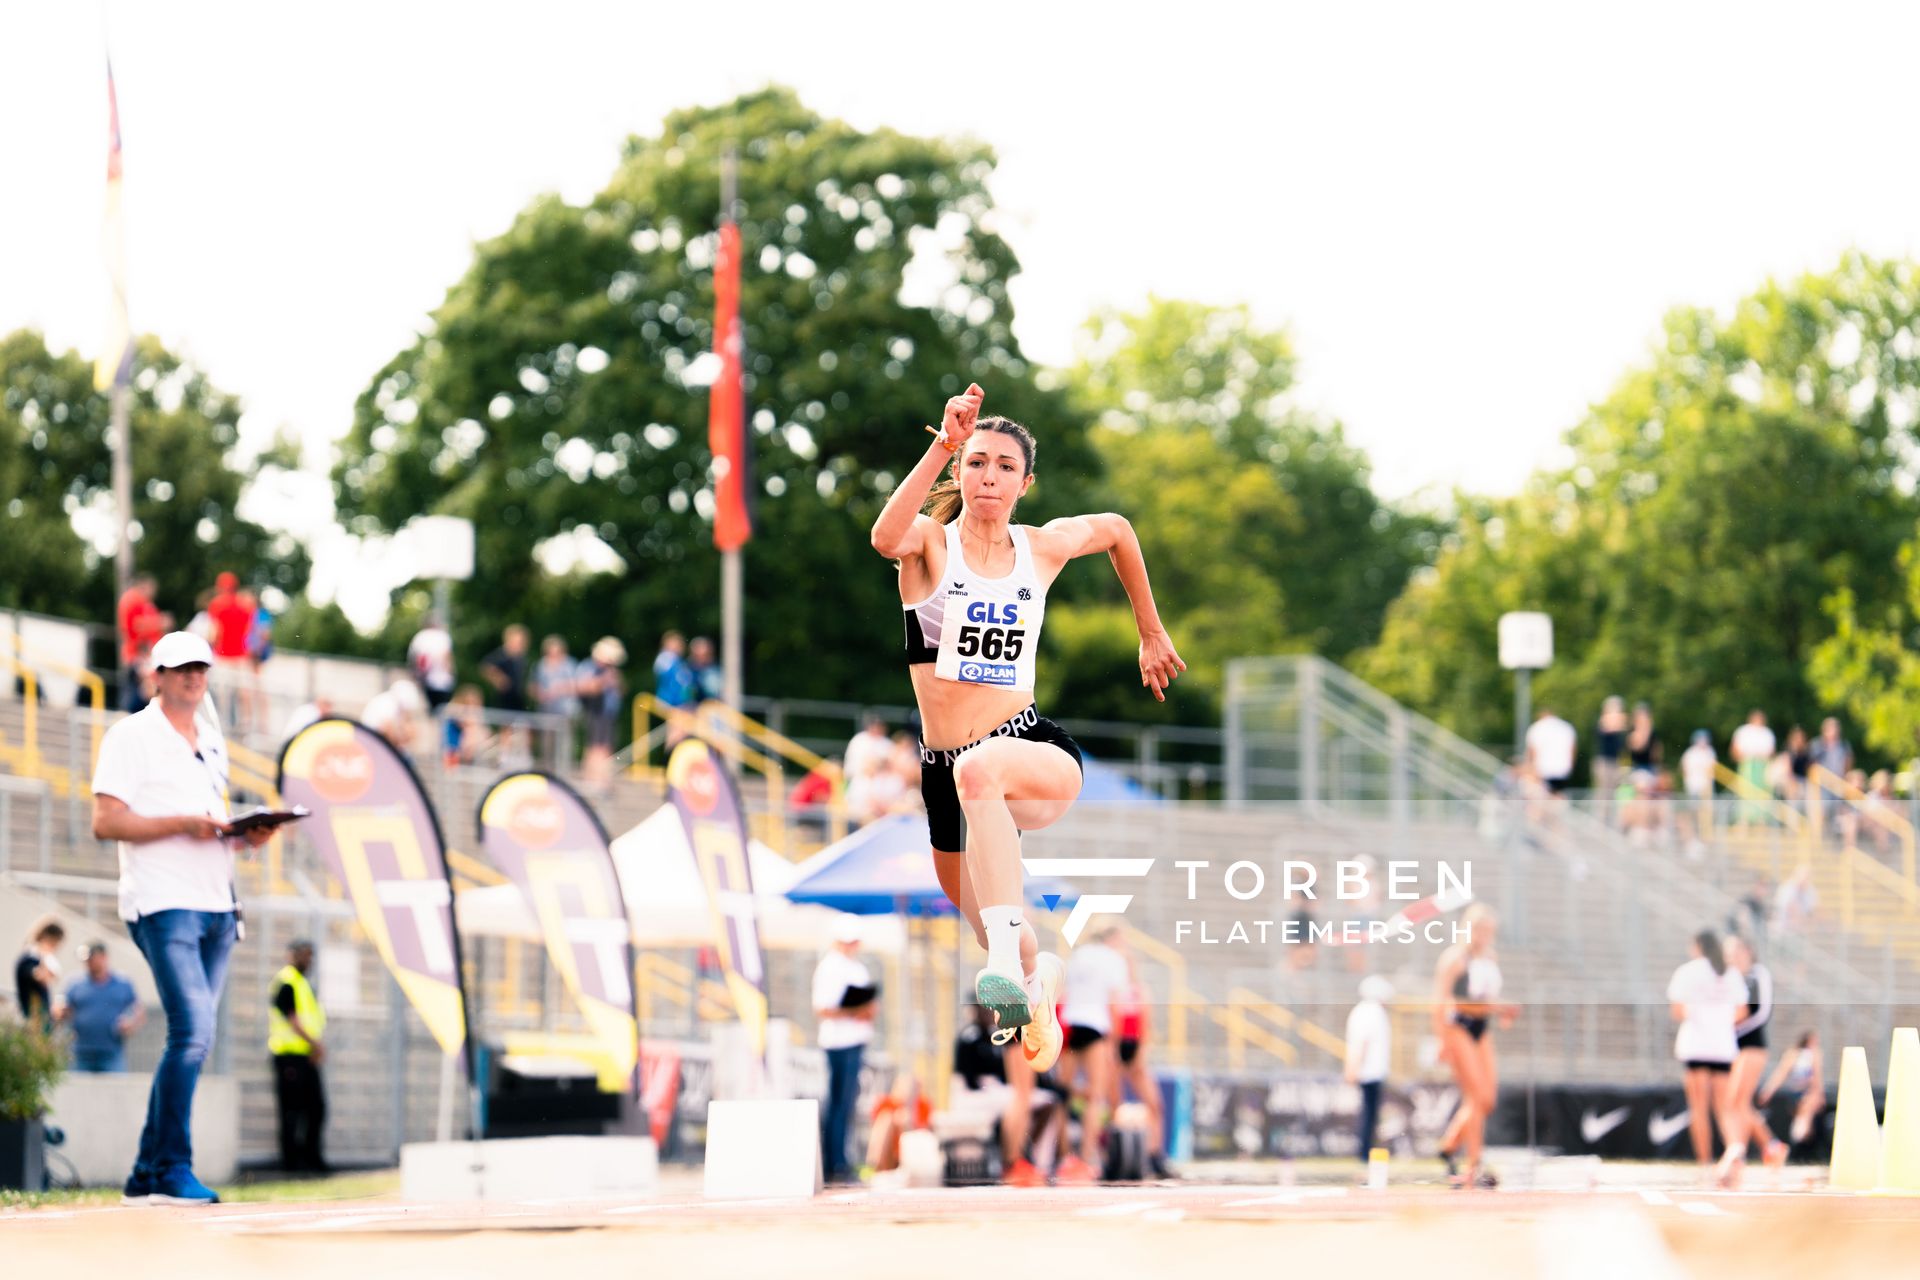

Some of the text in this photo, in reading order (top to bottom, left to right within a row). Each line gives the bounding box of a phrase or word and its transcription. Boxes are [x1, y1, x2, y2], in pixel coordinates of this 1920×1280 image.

[956, 625, 1026, 662] 565
[983, 667, 1014, 678] PLAN
[996, 706, 1038, 737] PRO
